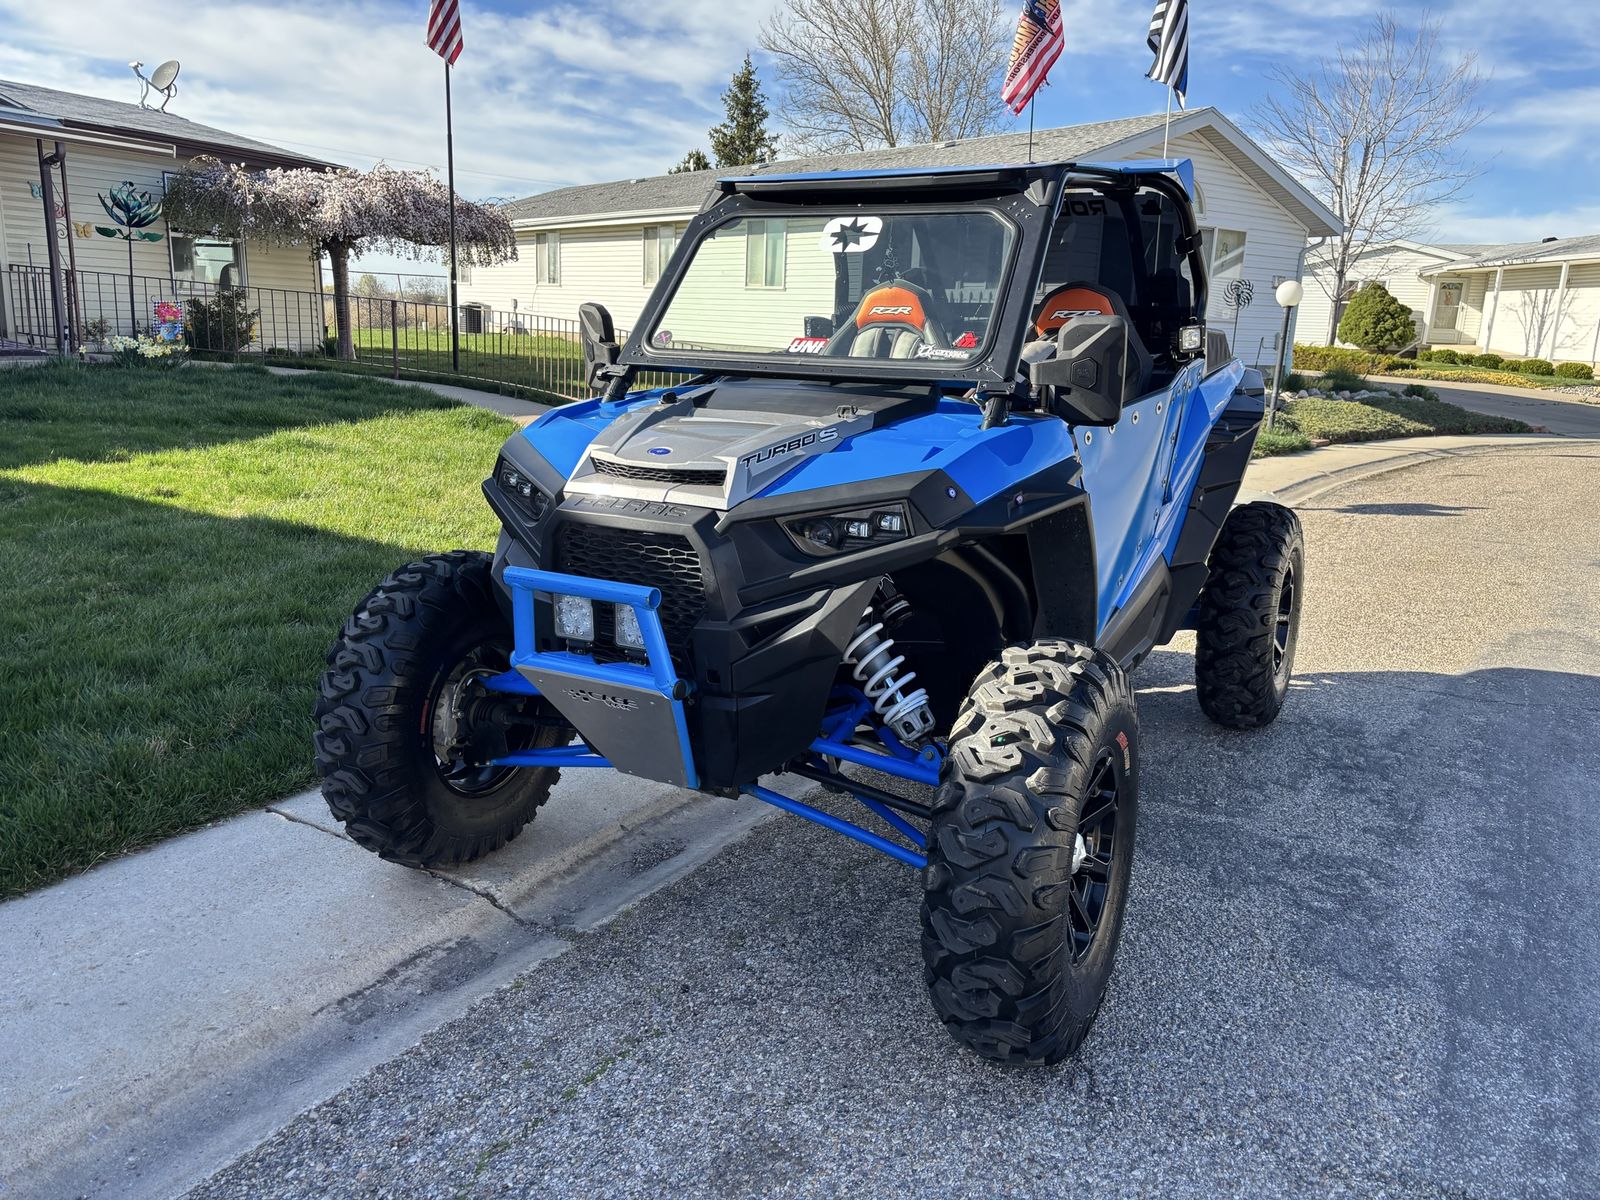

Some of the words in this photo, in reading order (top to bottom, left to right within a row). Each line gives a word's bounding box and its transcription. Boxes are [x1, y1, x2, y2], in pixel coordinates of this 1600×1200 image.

[868, 306, 913, 316] RZR
[740, 432, 817, 469] TURBO
[819, 427, 839, 443] S
[574, 497, 690, 517] POLARIS
